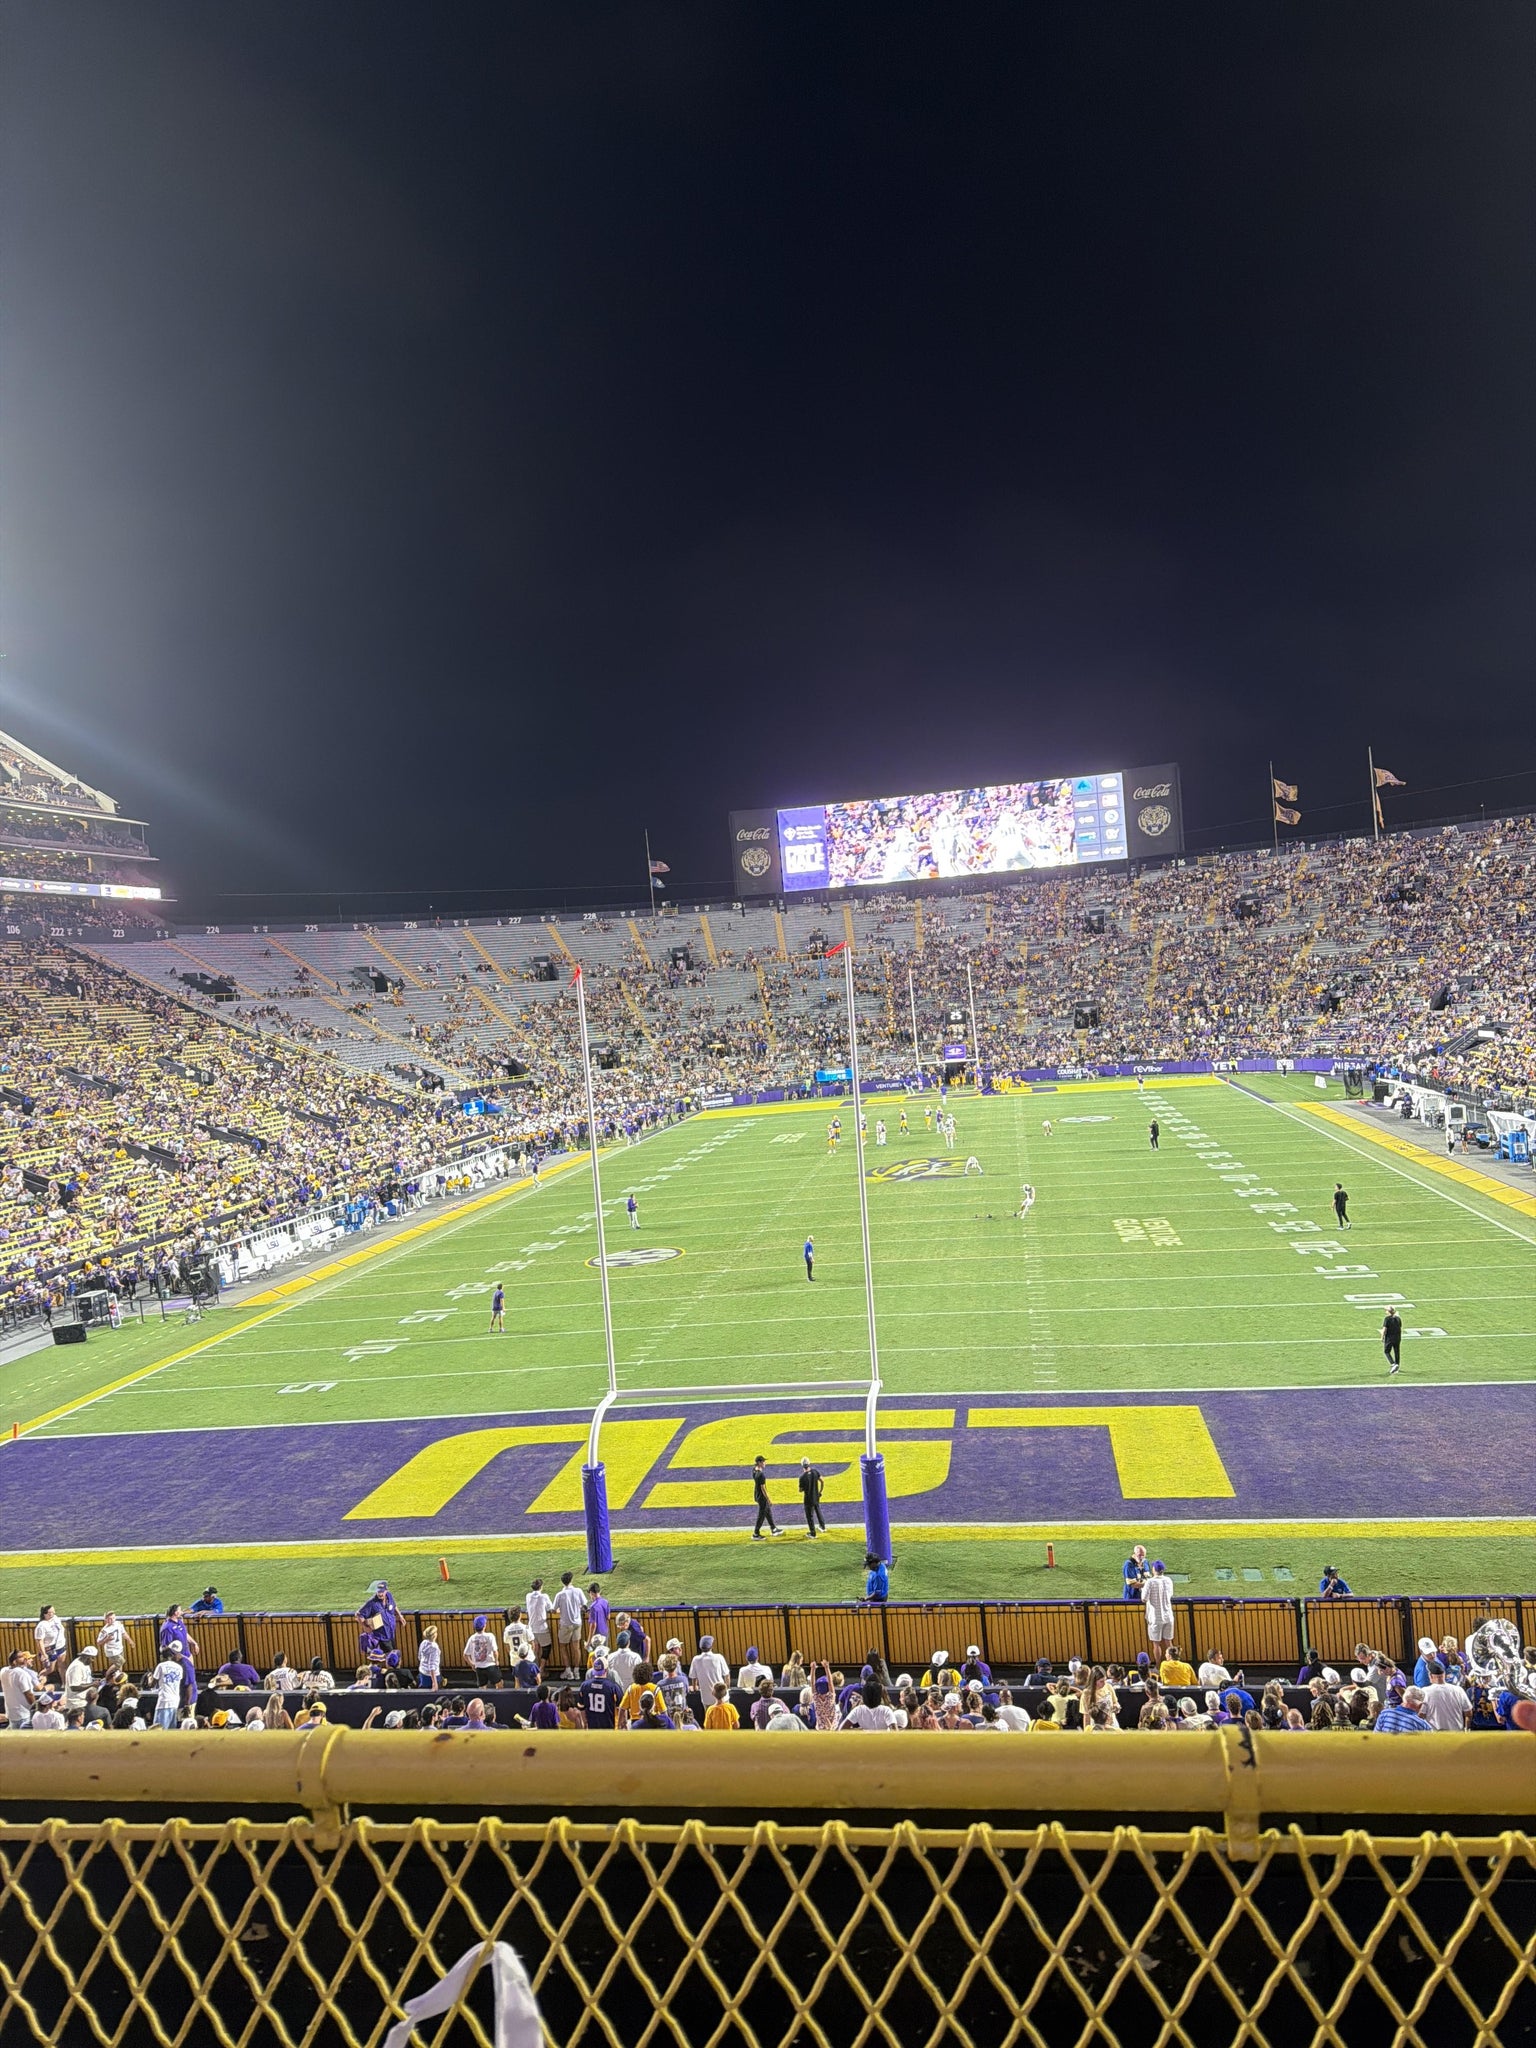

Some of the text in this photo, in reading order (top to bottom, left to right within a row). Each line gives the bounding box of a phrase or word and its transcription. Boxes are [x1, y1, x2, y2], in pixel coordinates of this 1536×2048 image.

[732, 902, 745, 910] 23
[508, 916, 522, 924] 227
[583, 912, 597, 920] 228
[6, 925, 21, 935] 106
[206, 926, 220, 934] 224
[304, 924, 319, 933] 225
[404, 921, 418, 929] 226
[50, 927, 65, 937] 222
[112, 928, 126, 937] 223
[1249, 1202, 1299, 1214] 30
[1141, 1216, 1184, 1247] VENTURE
[1267, 1220, 1323, 1233] 25
[266, 1236, 280, 1250] LSU
[1289, 1240, 1350, 1255] 20
[1314, 1264, 1380, 1280] 15
[1343, 1292, 1417, 1310] 10
[398, 1307, 459, 1324] 15
[341, 1337, 411, 1357] 10
[276, 1382, 339, 1395] 5
[343, 1404, 1236, 1520] LSU
[588, 1692, 606, 1713] 18
